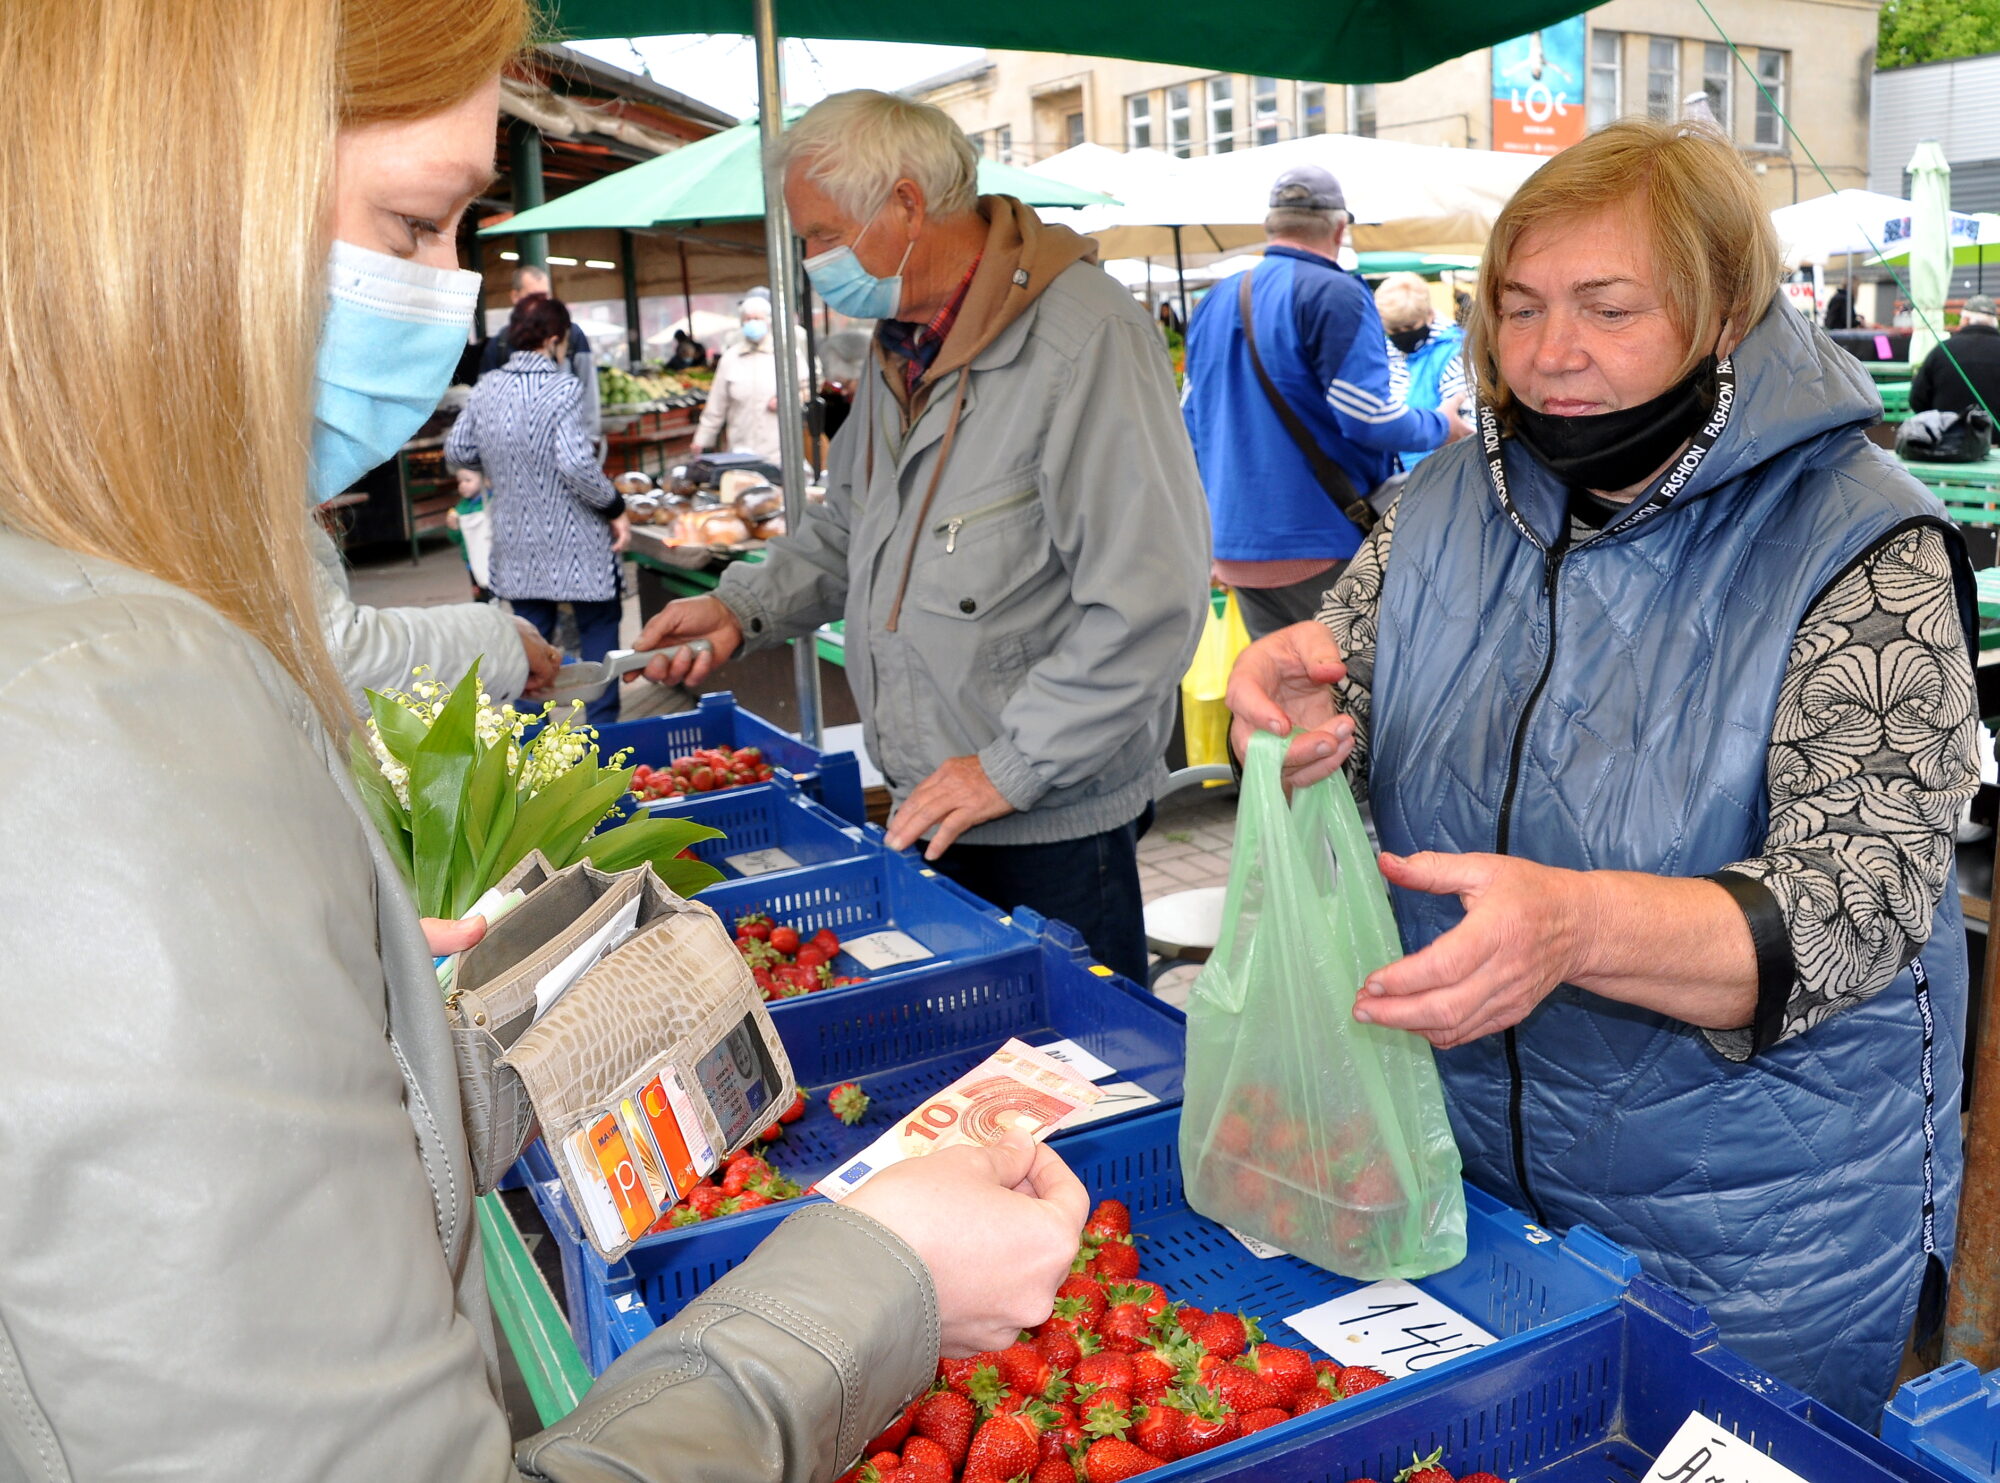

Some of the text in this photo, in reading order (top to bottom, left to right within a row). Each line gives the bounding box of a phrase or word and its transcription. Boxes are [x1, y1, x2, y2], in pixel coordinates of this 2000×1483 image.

[1511, 83, 1567, 122] LOC
[1480, 406, 1500, 454] FASHION
[1660, 445, 1707, 497] FASHION
[1703, 381, 1734, 438] FASHION
[1489, 459, 1509, 508] FASHION
[1918, 989, 1934, 1040] FASHION
[1922, 1045, 1933, 1097] FASHION
[904, 1103, 959, 1141] 10
[1924, 1213, 1935, 1254] FASHIO
